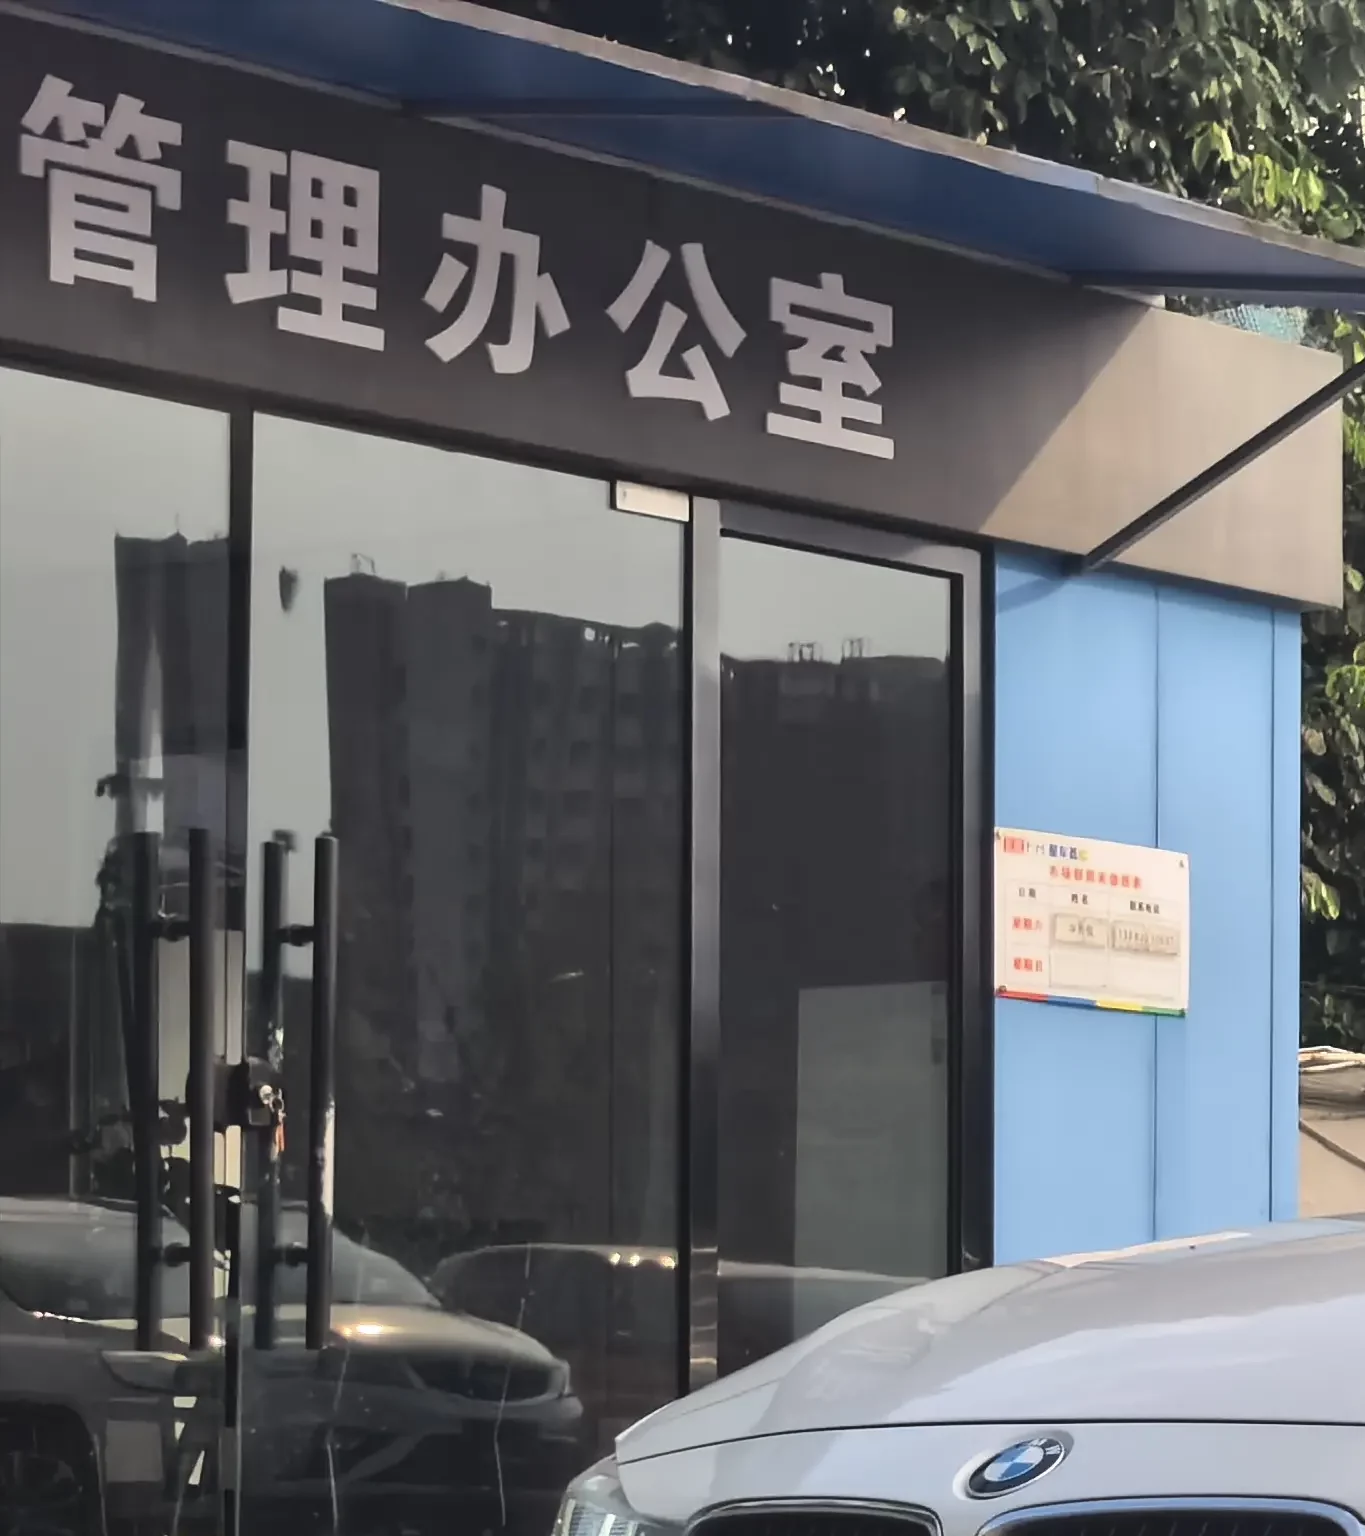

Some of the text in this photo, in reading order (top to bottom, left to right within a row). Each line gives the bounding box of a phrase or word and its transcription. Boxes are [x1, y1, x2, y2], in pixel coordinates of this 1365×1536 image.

[19, 73, 895, 460] 管理办公室
